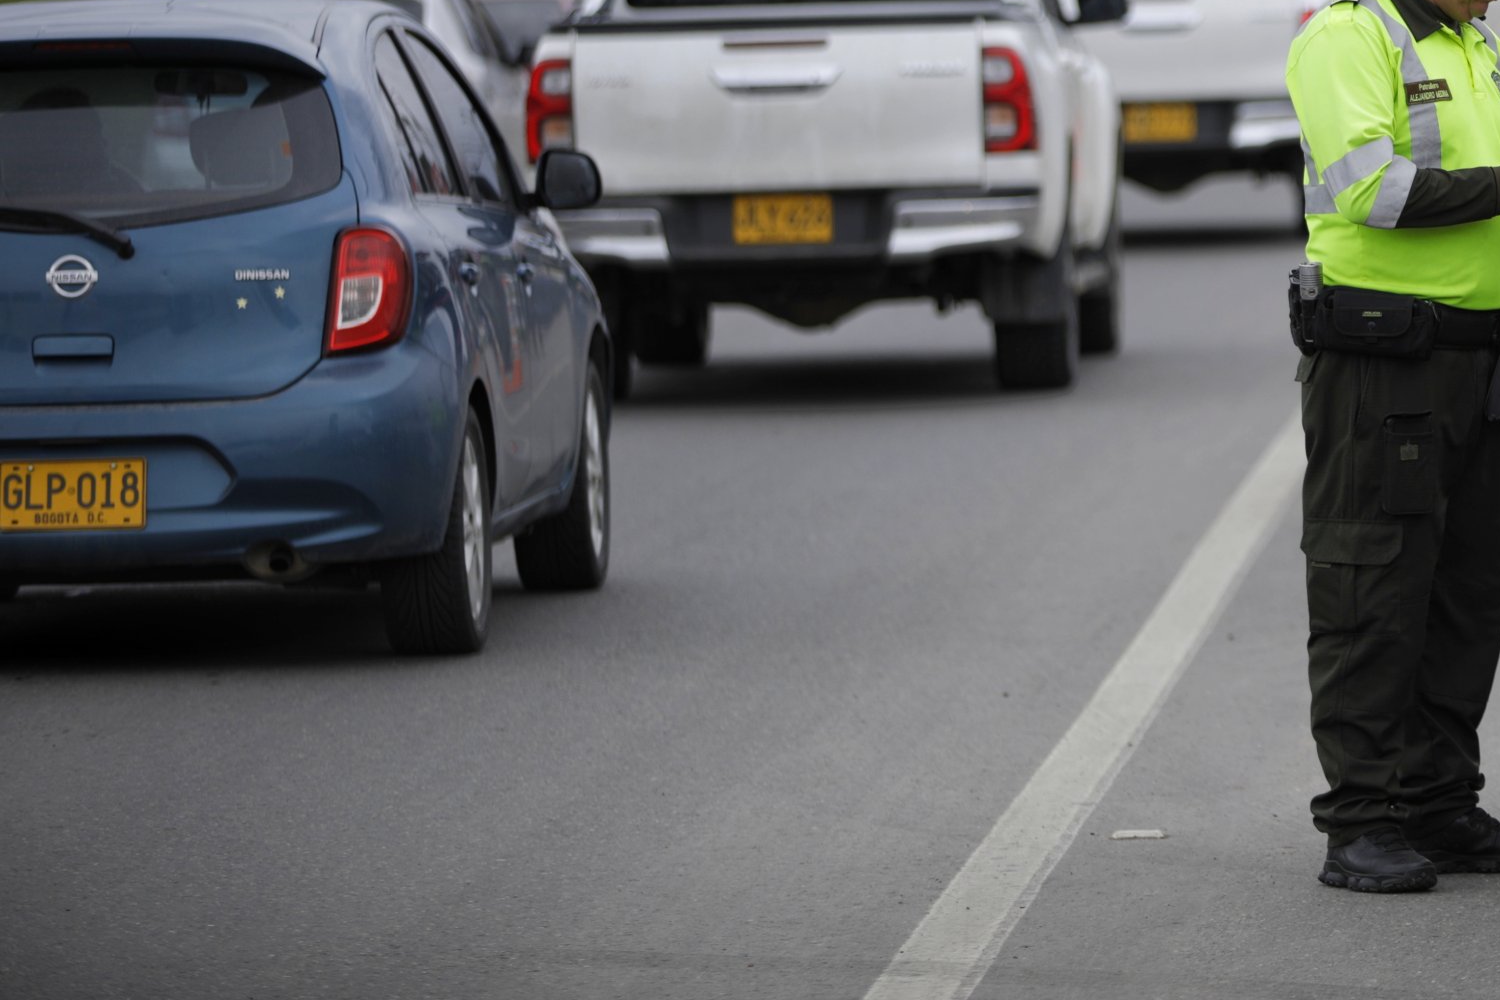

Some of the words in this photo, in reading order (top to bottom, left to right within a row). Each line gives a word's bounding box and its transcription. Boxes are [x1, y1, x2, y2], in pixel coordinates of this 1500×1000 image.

[51, 273, 92, 282] NISSAN
[235, 269, 290, 281] DINISSAN
[34, 511, 79, 524] BOGOTA
